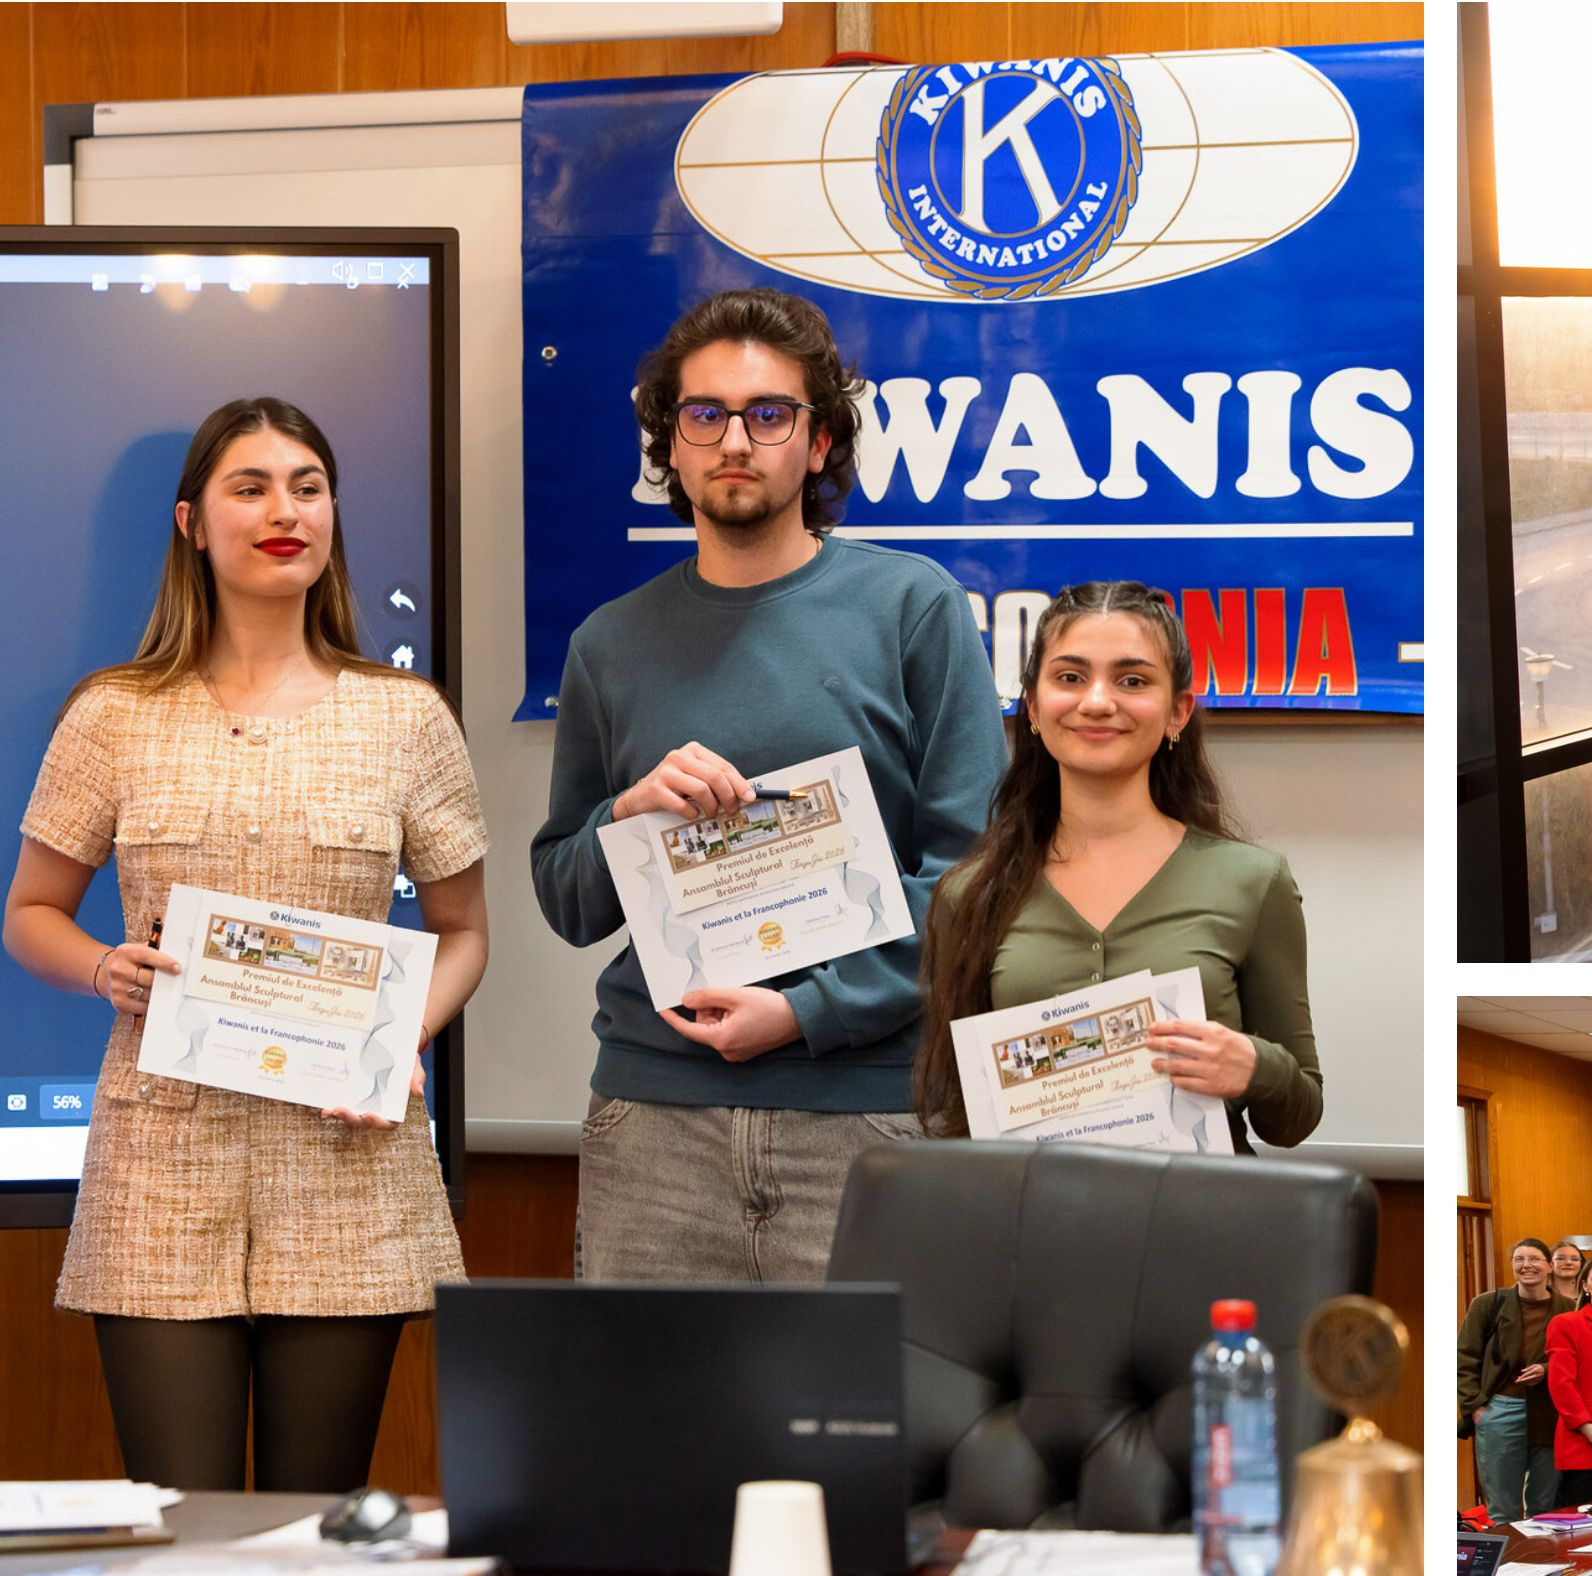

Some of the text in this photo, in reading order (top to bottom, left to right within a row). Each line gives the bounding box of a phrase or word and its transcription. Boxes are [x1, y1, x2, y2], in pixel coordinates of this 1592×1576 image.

[908, 180, 1108, 268] INTERNATIONAL
[630, 368, 1414, 506] WANIS
[1165, 586, 1358, 697] NIA
[716, 853, 754, 872] Premiul
[755, 850, 768, 861] de
[683, 873, 733, 898] Ansamblul
[735, 858, 783, 881] Sculptural
[280, 912, 322, 929] Kiwanis
[701, 916, 734, 931] Kiwanis
[734, 911, 743, 922] et
[752, 892, 807, 916] Francophonie
[808, 887, 828, 900] 2026
[200, 974, 304, 1003] Ansamblul Sculptural
[242, 968, 280, 985] Premiul
[282, 977, 294, 988] de
[1051, 1001, 1090, 1018] Kiwanis
[218, 1016, 249, 1031] Kiwanis
[250, 1024, 259, 1033] et
[270, 1028, 325, 1047] Francophonie
[326, 1039, 347, 1051] 2026
[1041, 1073, 1077, 1090] Premiul
[1078, 1069, 1090, 1080] de
[52, 1095, 82, 1109] 56%
[1009, 1094, 1057, 1115] Ansamblul
[1058, 1079, 1105, 1100] Sculptural
[1066, 1128, 1074, 1138] et
[1083, 1116, 1134, 1134] Francophonie
[1136, 1111, 1155, 1124] 2026
